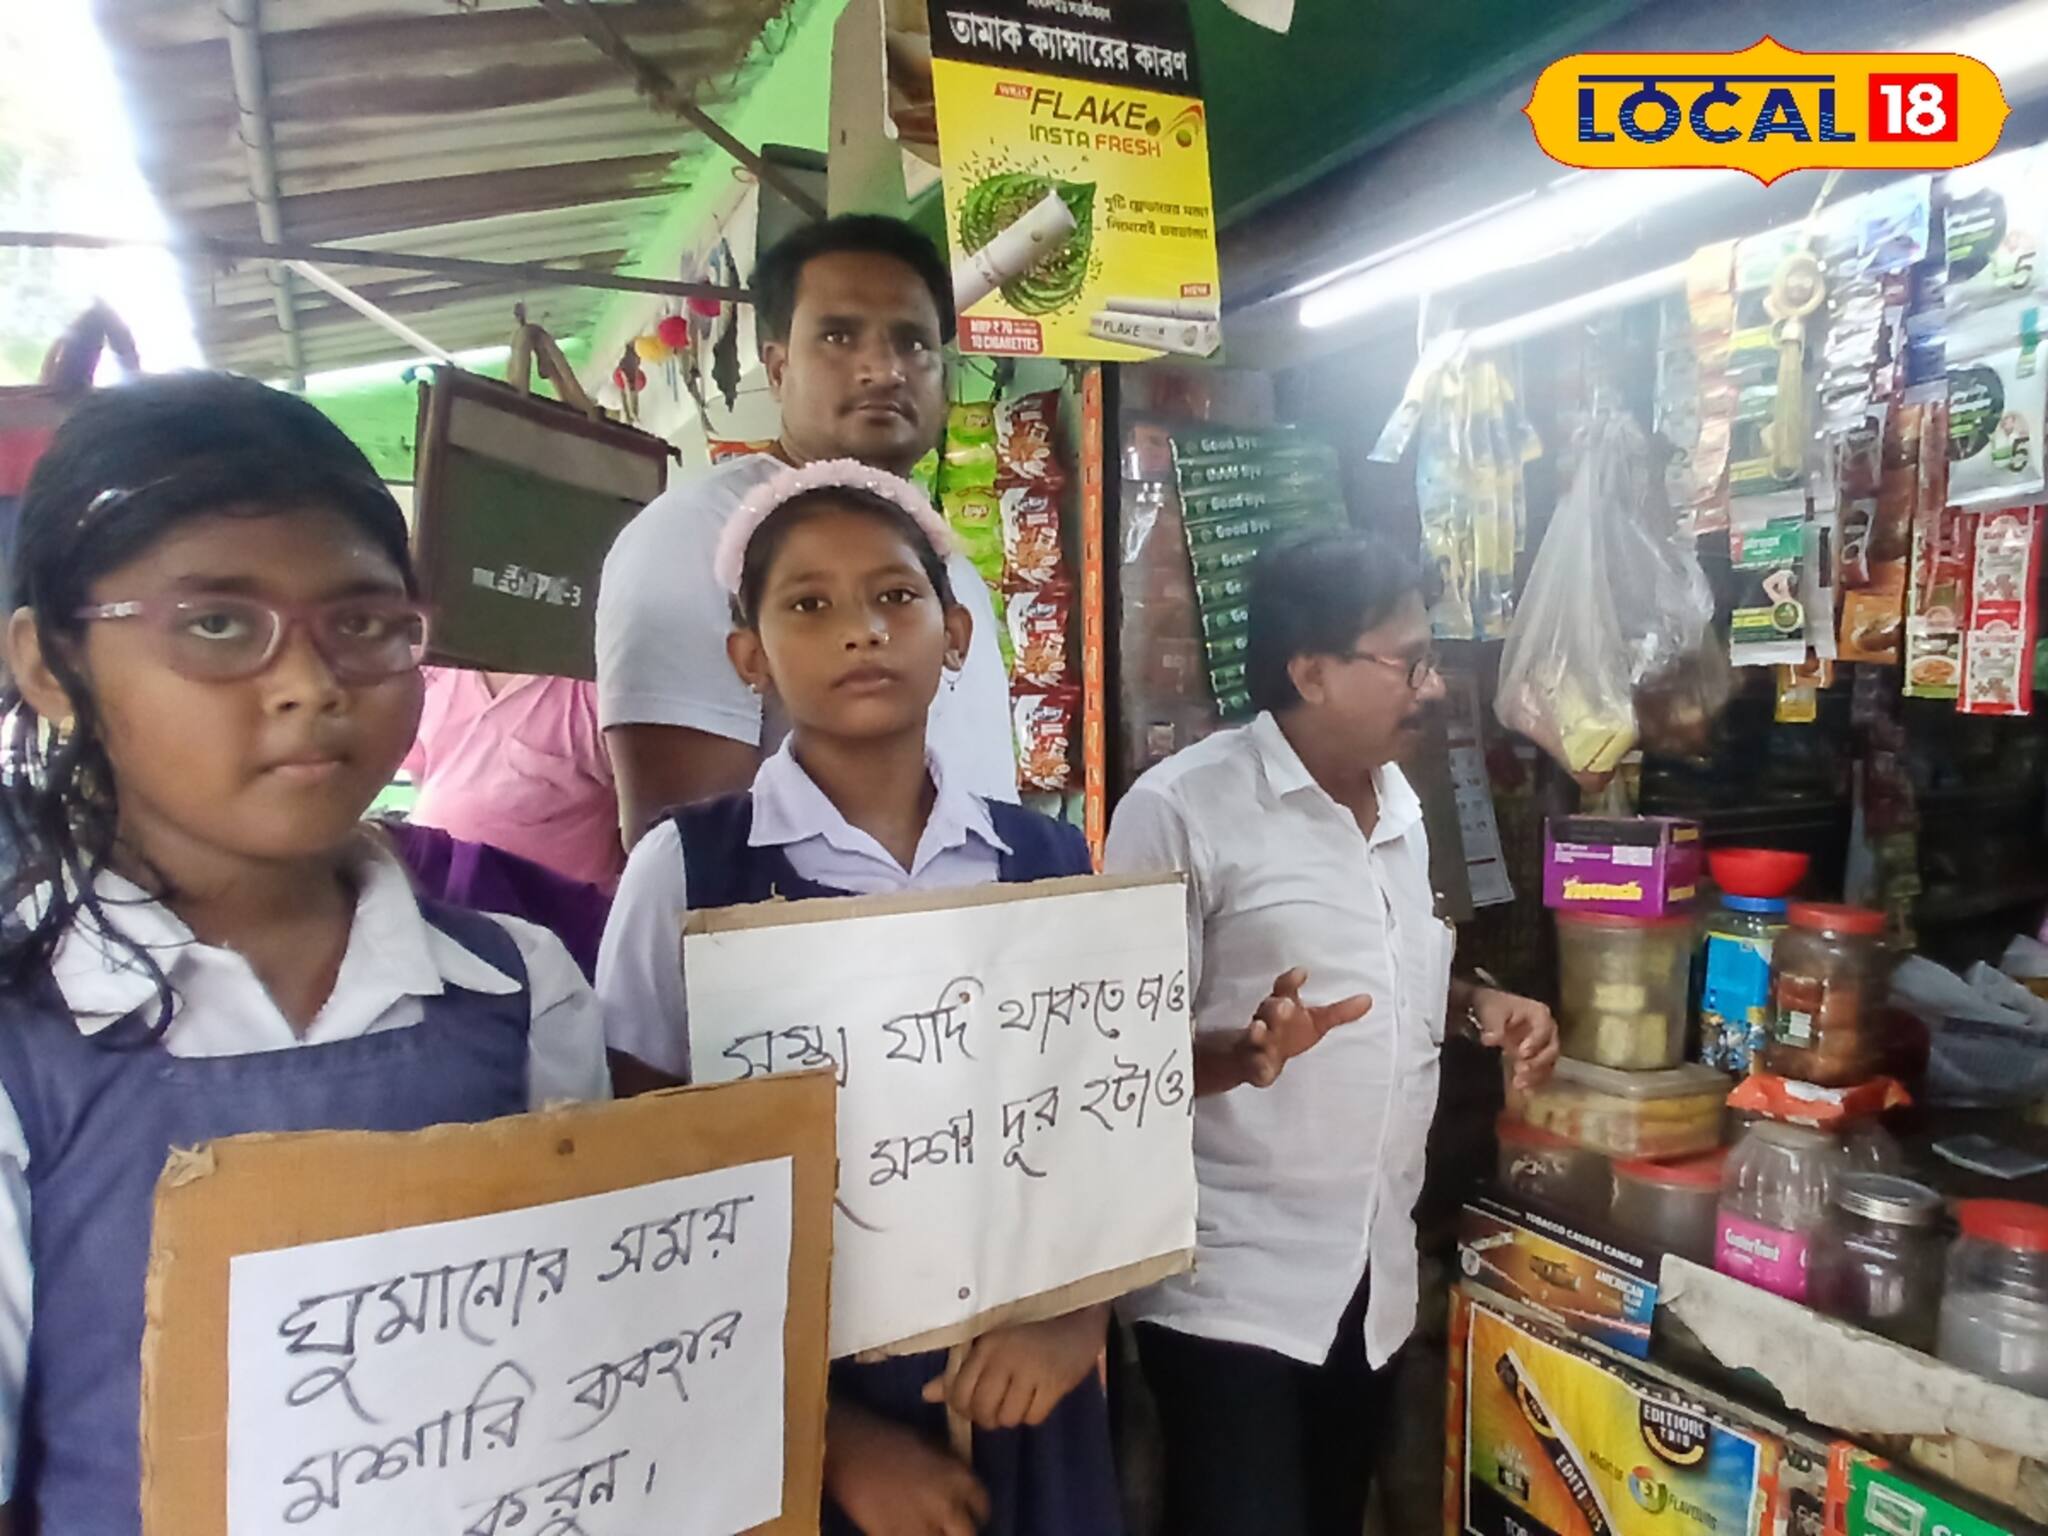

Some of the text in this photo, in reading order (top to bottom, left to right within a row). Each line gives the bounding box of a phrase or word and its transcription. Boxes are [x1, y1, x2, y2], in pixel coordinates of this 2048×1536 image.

[946, 10, 1022, 54] তামাক
[1131, 42, 1190, 82] কারণ
[1030, 88, 1148, 131] FLAKE
[1094, 132, 1163, 158] FRESH
[1103, 321, 1140, 338] FLAKE
[2009, 436, 2030, 473] 5
[868, 1107, 975, 1187] মশা
[1001, 1085, 1060, 1178] দূর
[1603, 1244, 1645, 1269] CANCER
[277, 1194, 755, 1425] ঘুমানোর সময়
[281, 1309, 744, 1525] মশারি ব্যবহার
